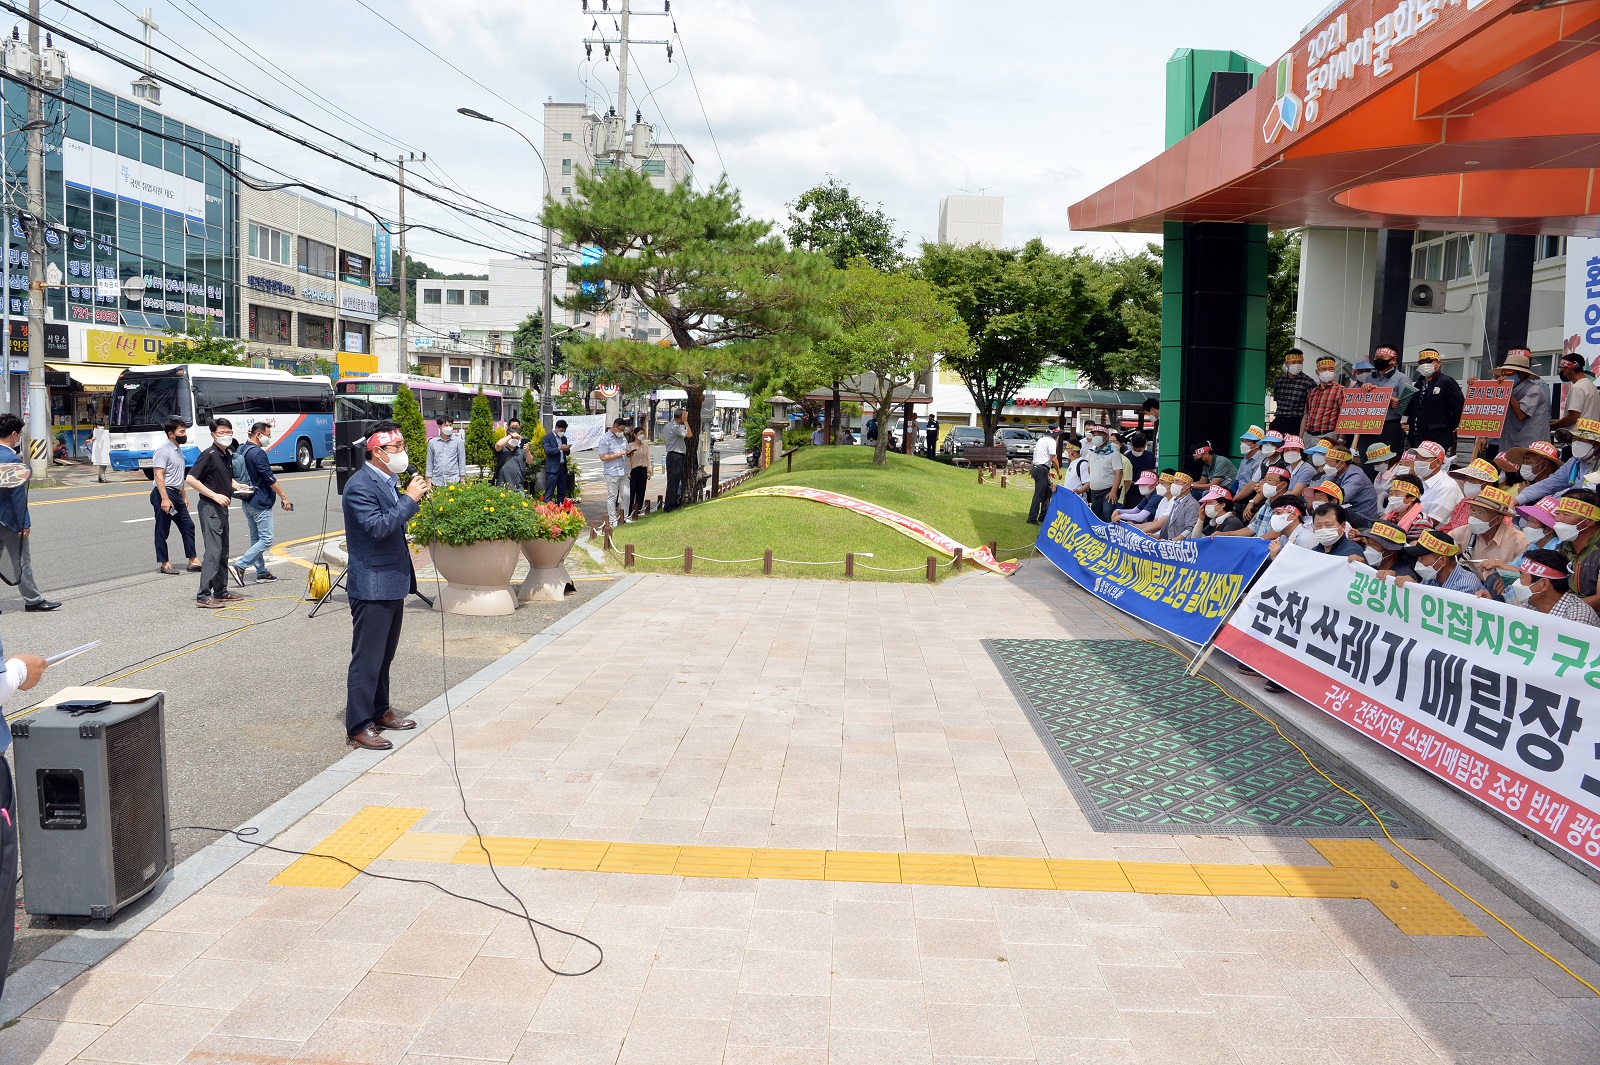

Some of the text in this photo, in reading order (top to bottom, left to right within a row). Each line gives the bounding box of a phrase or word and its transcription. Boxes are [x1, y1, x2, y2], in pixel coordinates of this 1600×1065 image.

[1308, 12, 1348, 67] 2021
[129, 178, 141, 189] 국민
[1361, 420, 1383, 430] 살인자
[1328, 449, 1346, 459] 반대
[1372, 523, 1396, 539] 반대
[1520, 558, 1546, 575] 반대
[1162, 567, 1199, 609] 조성
[1347, 571, 1410, 623] 광양시
[1420, 594, 1539, 666] 인접지역
[1250, 585, 1309, 649] 순천
[1305, 606, 1418, 702] 쓰레기
[1418, 648, 1583, 773] 매립장
[1324, 685, 1350, 712] 구상
[1352, 701, 1405, 743] 건천지역
[1401, 729, 1489, 790] 쓰레기매립장
[1487, 771, 1527, 811] 조성
[1527, 790, 1570, 834] 반대
